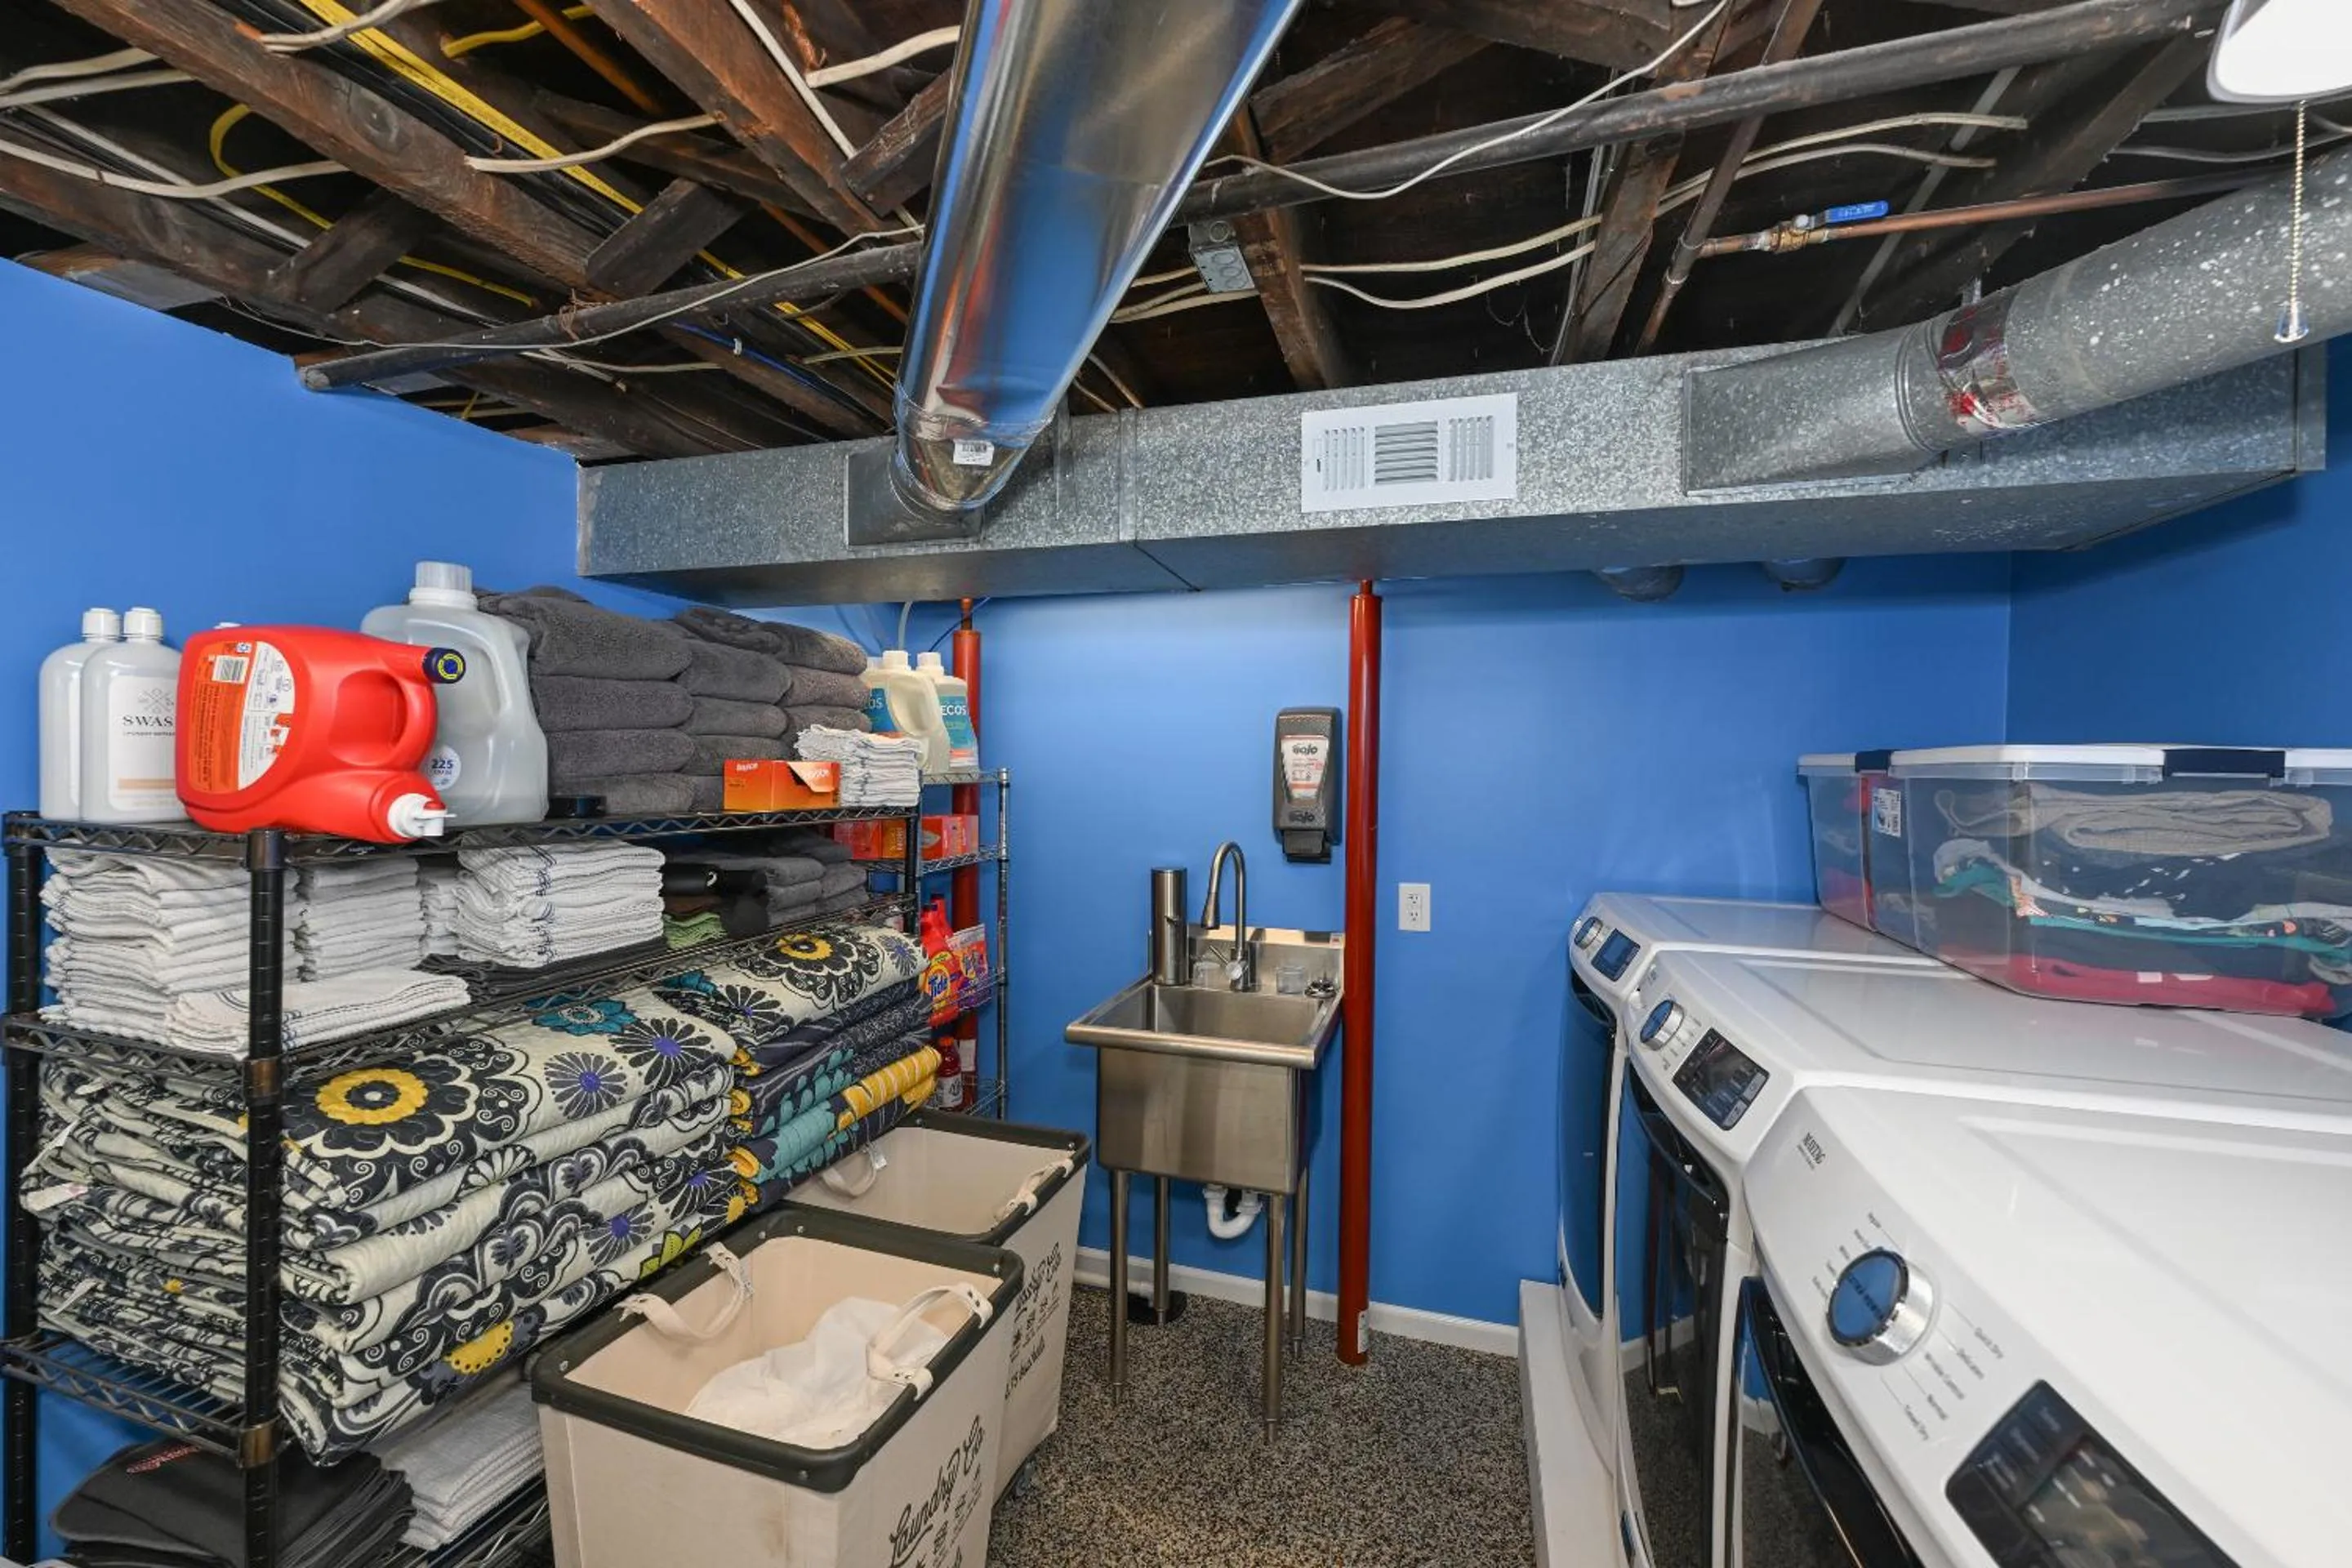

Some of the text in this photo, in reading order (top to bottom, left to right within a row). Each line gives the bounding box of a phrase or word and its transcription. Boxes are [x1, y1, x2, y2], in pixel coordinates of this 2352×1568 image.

[940, 705, 967, 716] ECOS
[122, 715, 174, 727] SWAS
[431, 758, 454, 769] 225
[928, 973, 948, 998] Tide
[888, 1447, 960, 1568] Laundry
